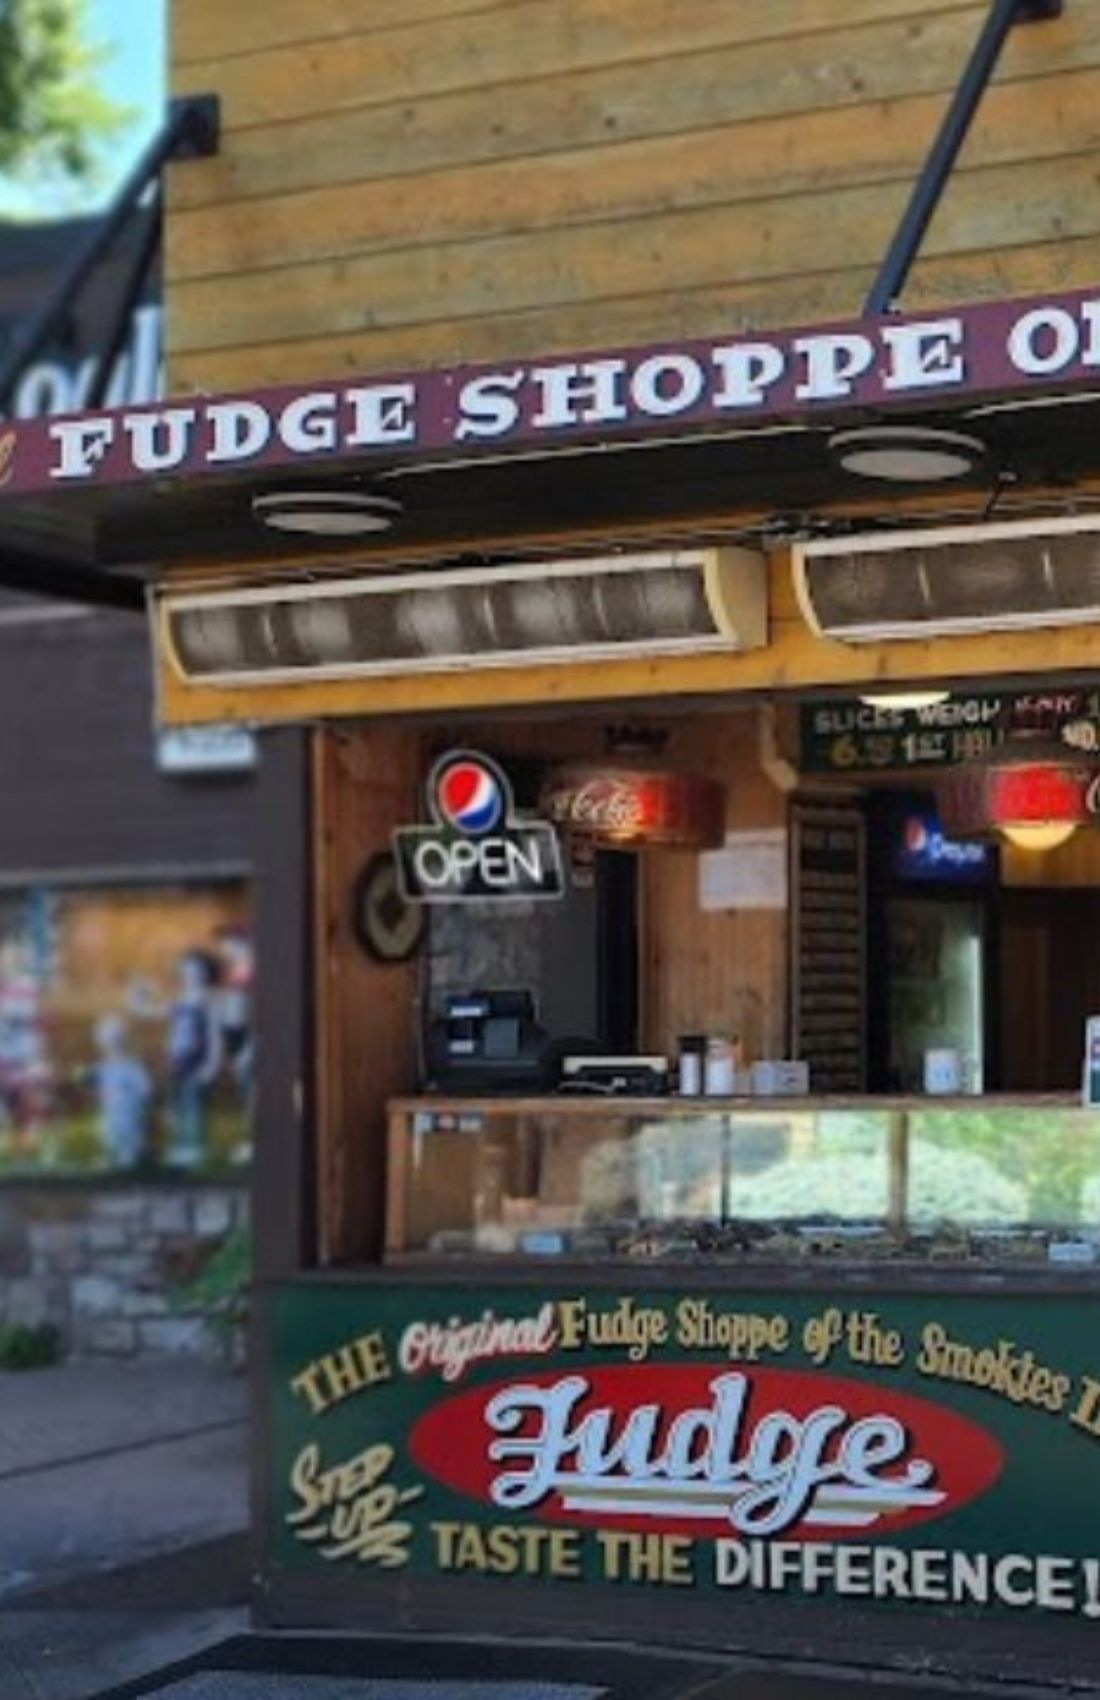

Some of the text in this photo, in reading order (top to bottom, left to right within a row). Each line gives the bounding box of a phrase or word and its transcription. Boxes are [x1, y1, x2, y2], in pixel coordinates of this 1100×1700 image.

[48, 383, 416, 478] FUDGE
[454, 317, 964, 441] SHOPPE
[413, 838, 542, 887] OPEN
[291, 1331, 393, 1415] THE
[399, 1301, 557, 1382] Original
[558, 1297, 669, 1361] Fudge
[676, 1297, 790, 1361] Shoppe
[803, 1307, 843, 1364] of
[847, 1311, 905, 1366] the
[916, 1321, 1071, 1411] Smokies
[484, 1371, 934, 1535] Fudge
[431, 1521, 580, 1576] TASTE
[597, 1529, 693, 1584] THE
